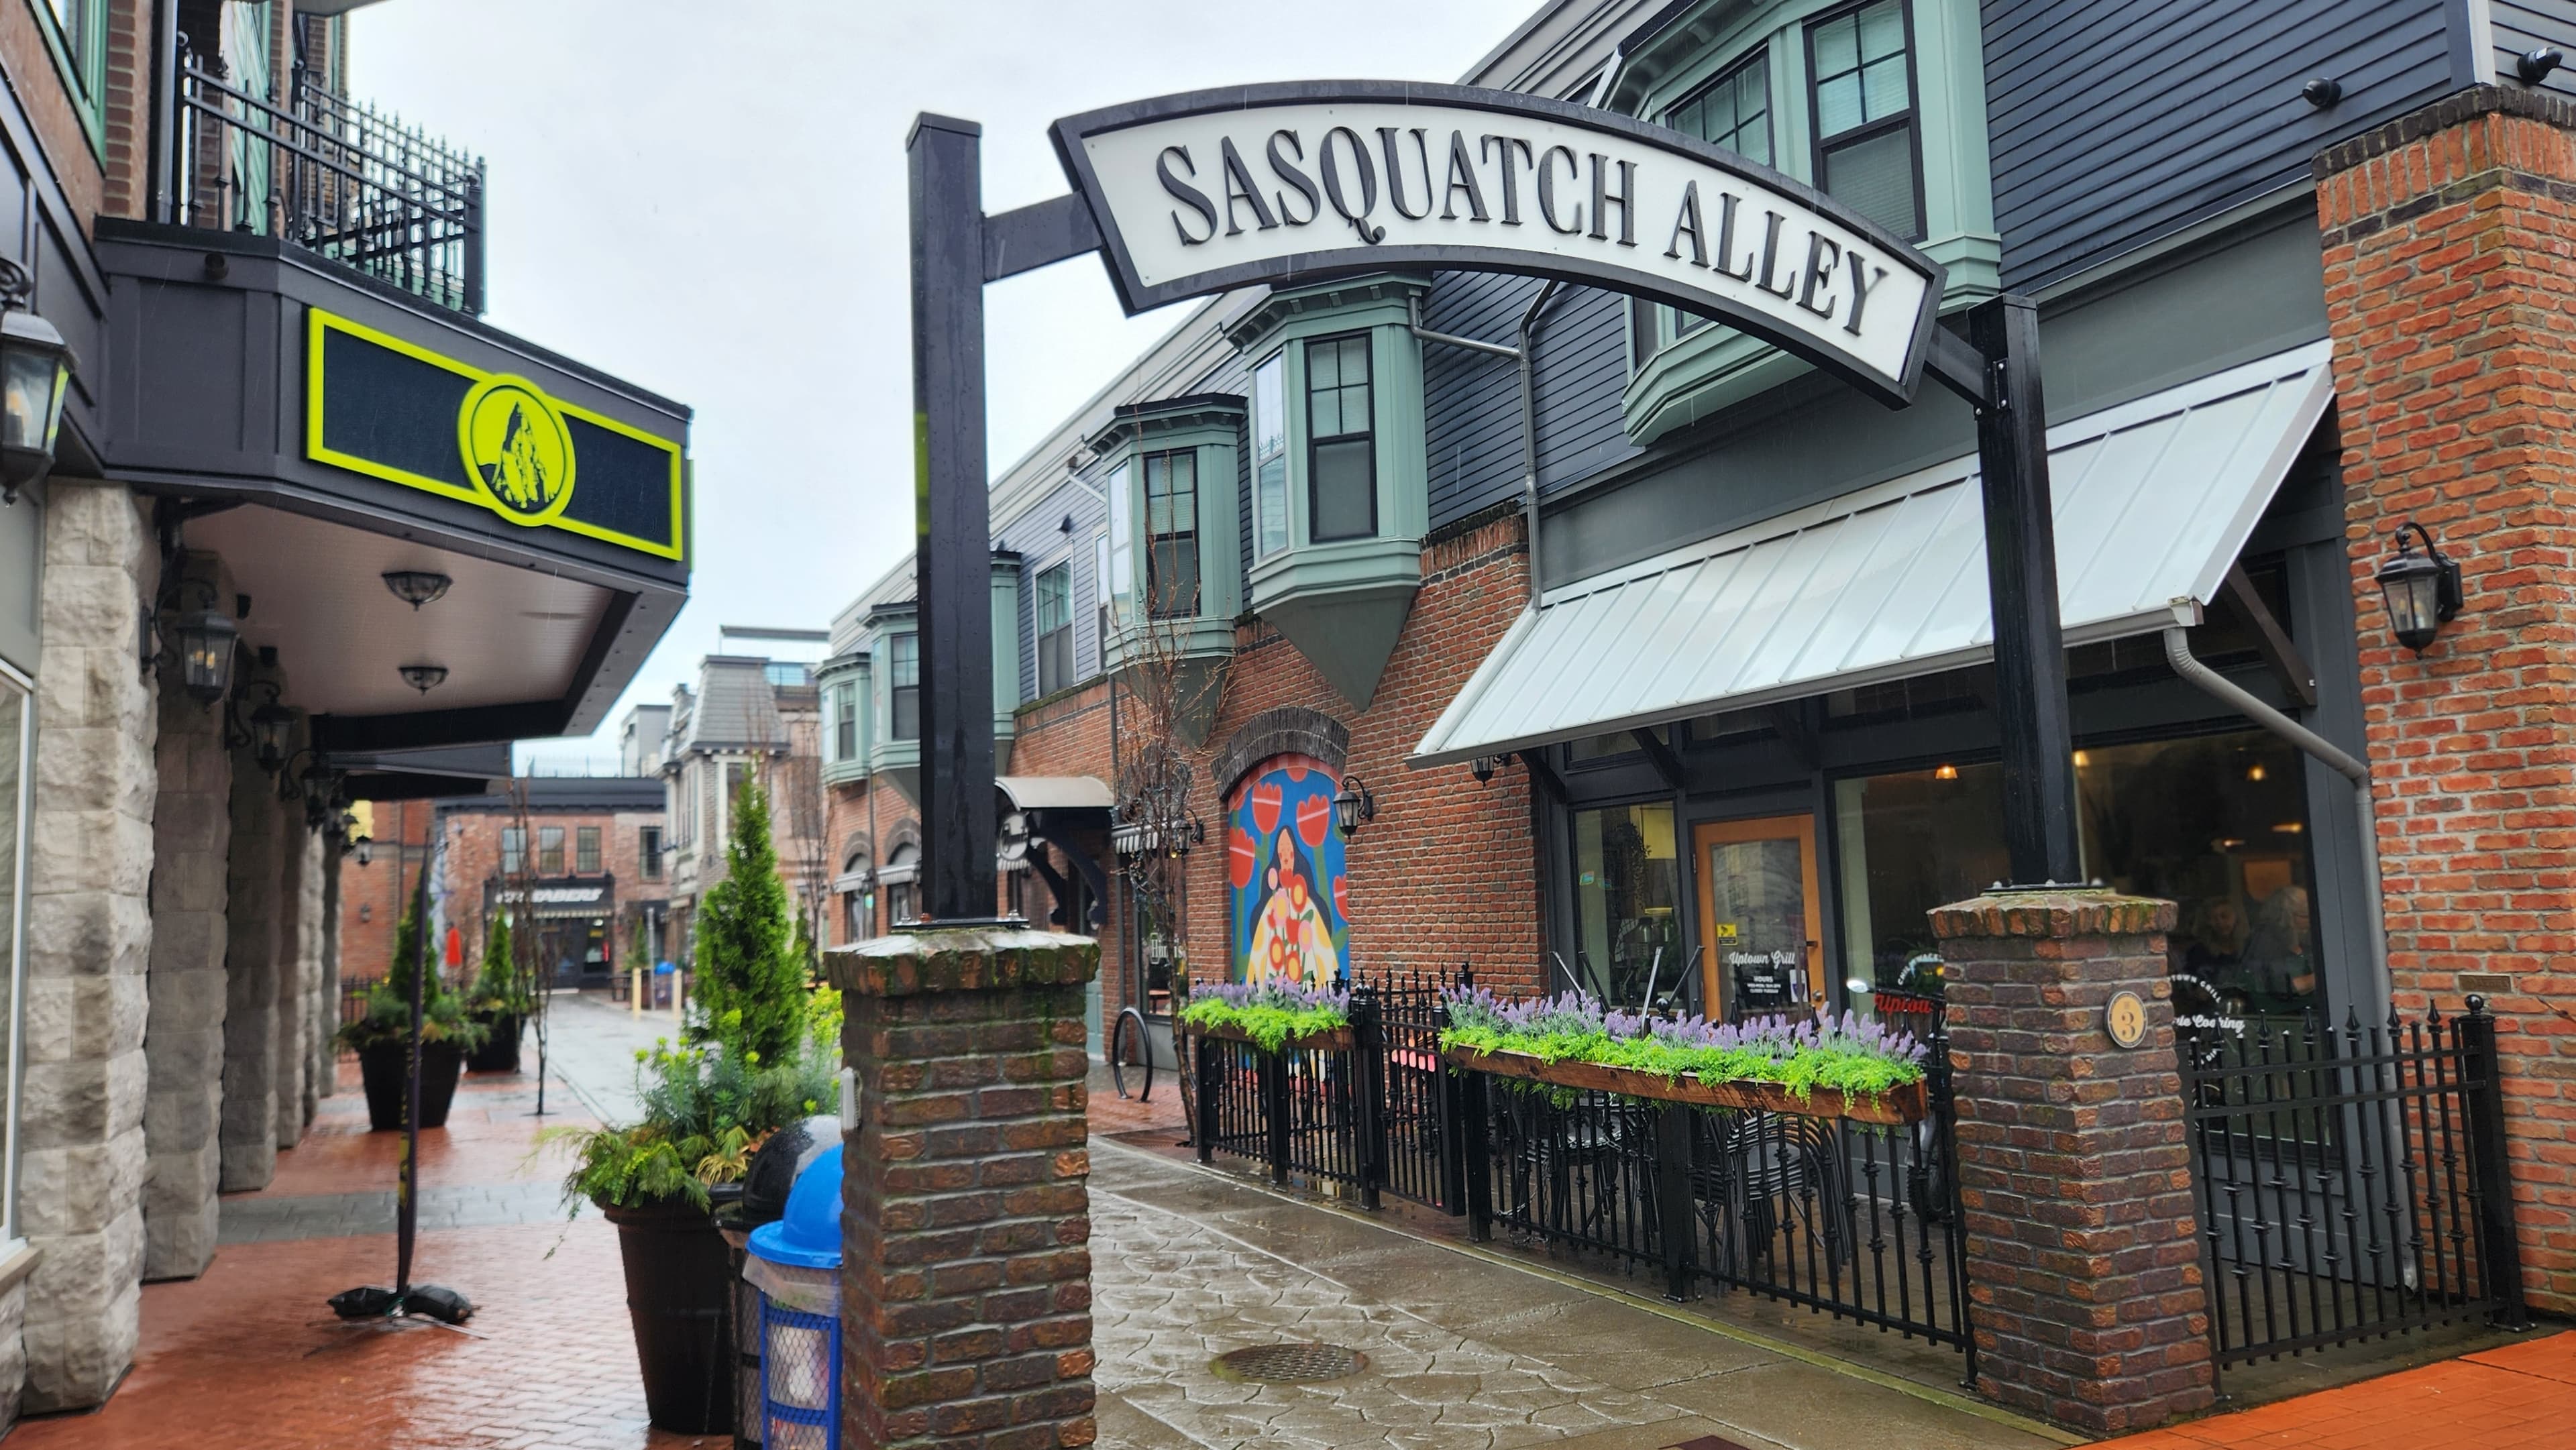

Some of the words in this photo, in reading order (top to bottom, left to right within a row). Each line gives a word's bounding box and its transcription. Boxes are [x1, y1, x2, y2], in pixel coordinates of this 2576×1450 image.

[1155, 126, 1640, 247] SASQUATCH
[1663, 179, 1890, 337] ALLEY
[1729, 951, 1769, 966] Uptown
[1770, 950, 1795, 970] Grill
[2167, 974, 2198, 983] TOWN
[2121, 1011, 2136, 1040] 3
